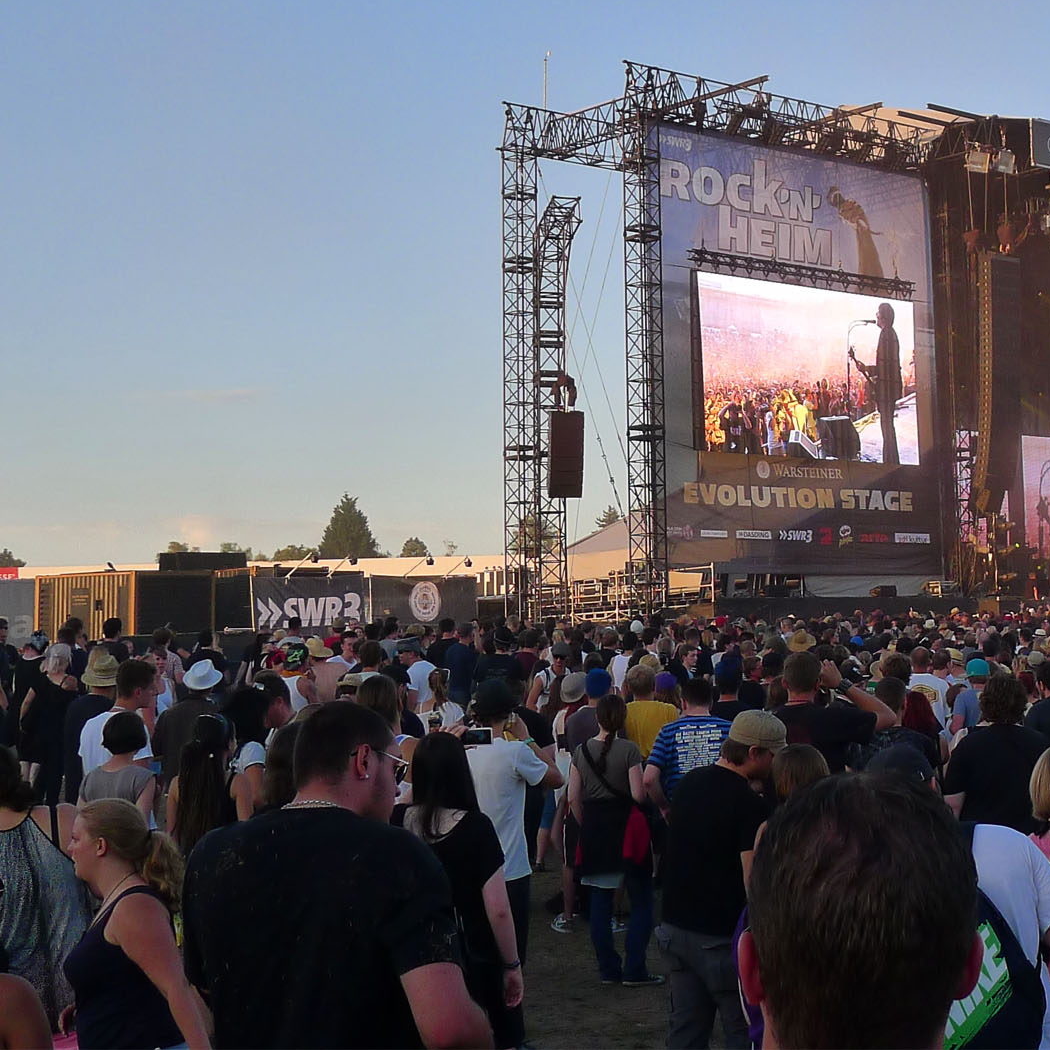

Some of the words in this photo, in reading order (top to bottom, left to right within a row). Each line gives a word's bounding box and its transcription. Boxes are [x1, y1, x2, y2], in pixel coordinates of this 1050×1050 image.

[718, 204, 833, 267] HEIM
[773, 463, 843, 480] WARSTEINER
[683, 481, 835, 509] EVOLUTION
[840, 488, 913, 512] STAGE
[787, 530, 813, 543] SWR3
[283, 592, 361, 628] SWR3
